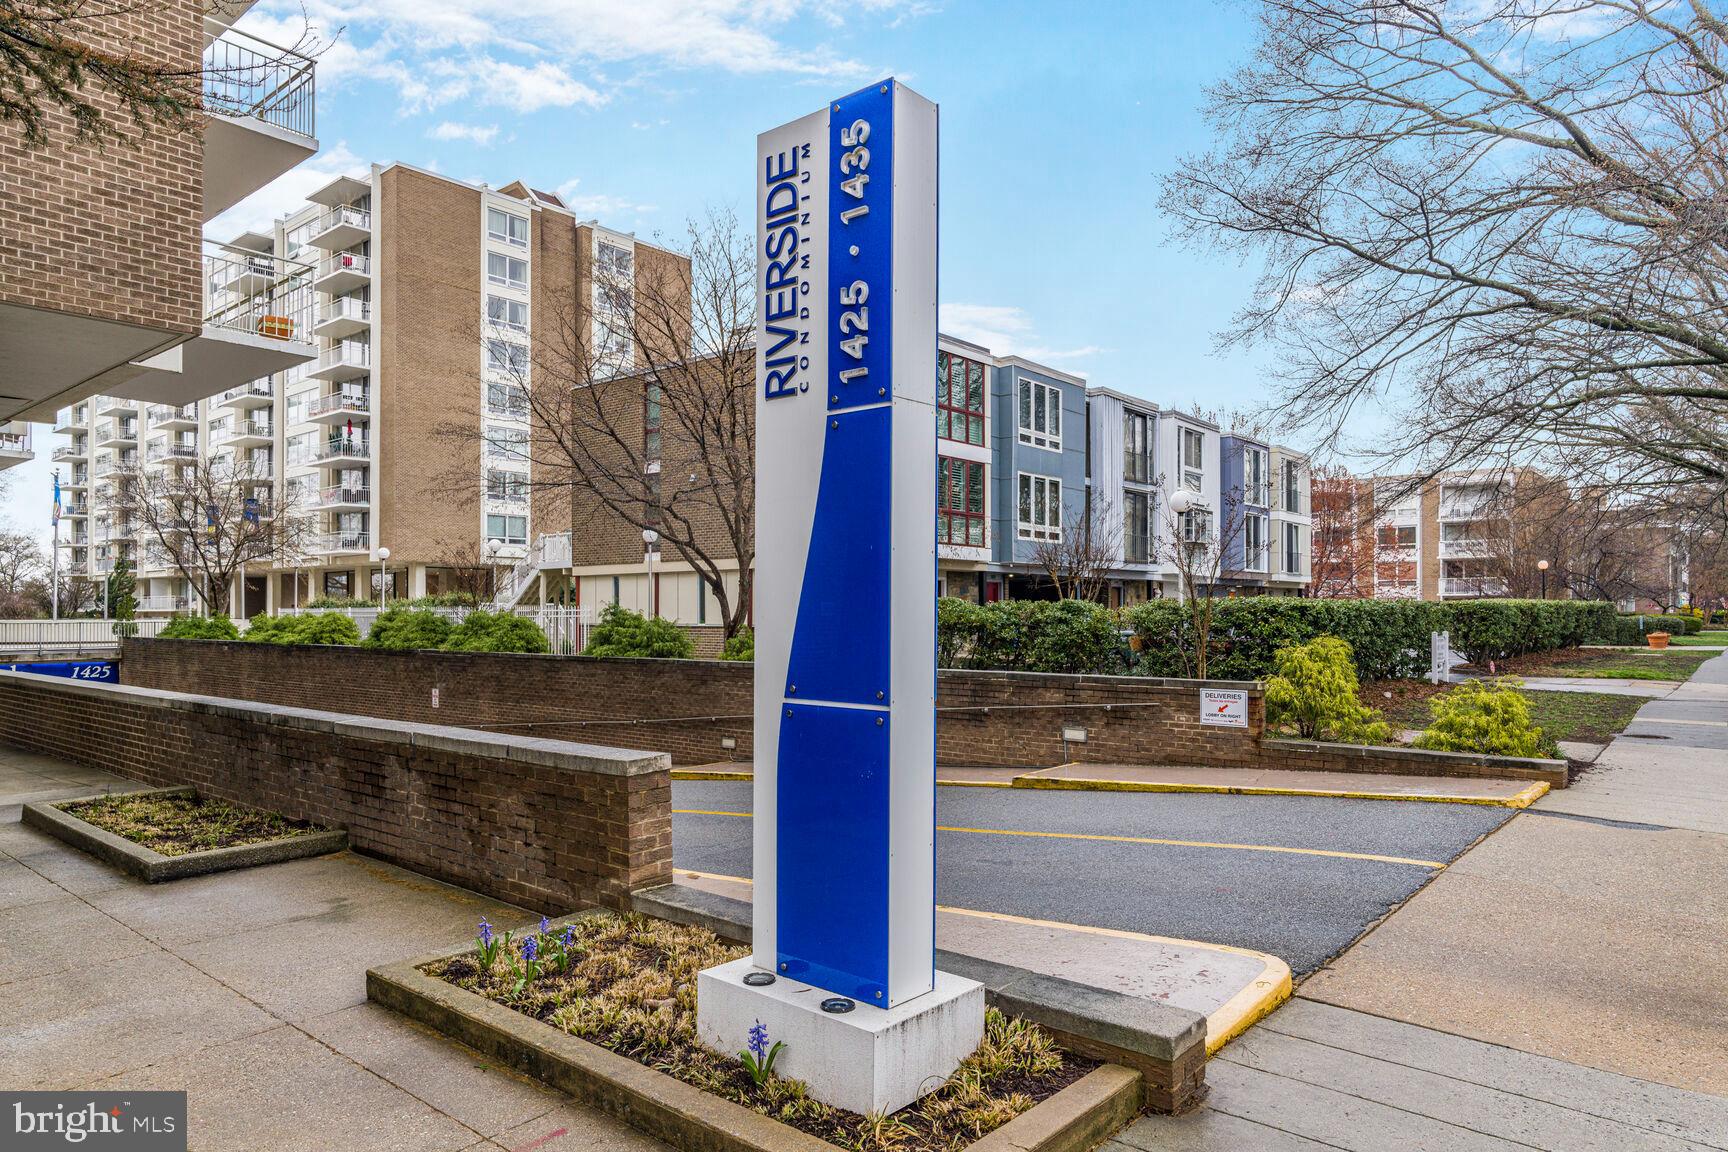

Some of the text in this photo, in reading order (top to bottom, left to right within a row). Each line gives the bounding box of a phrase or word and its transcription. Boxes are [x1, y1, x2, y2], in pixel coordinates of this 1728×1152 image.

[765, 145, 799, 402] RIVERSIDE
[799, 142, 811, 394] CONDOMINIUM
[839, 118, 871, 384] 1425 1435
[70, 665, 111, 679] 1425
[1205, 692, 1242, 700] DELIVERIES
